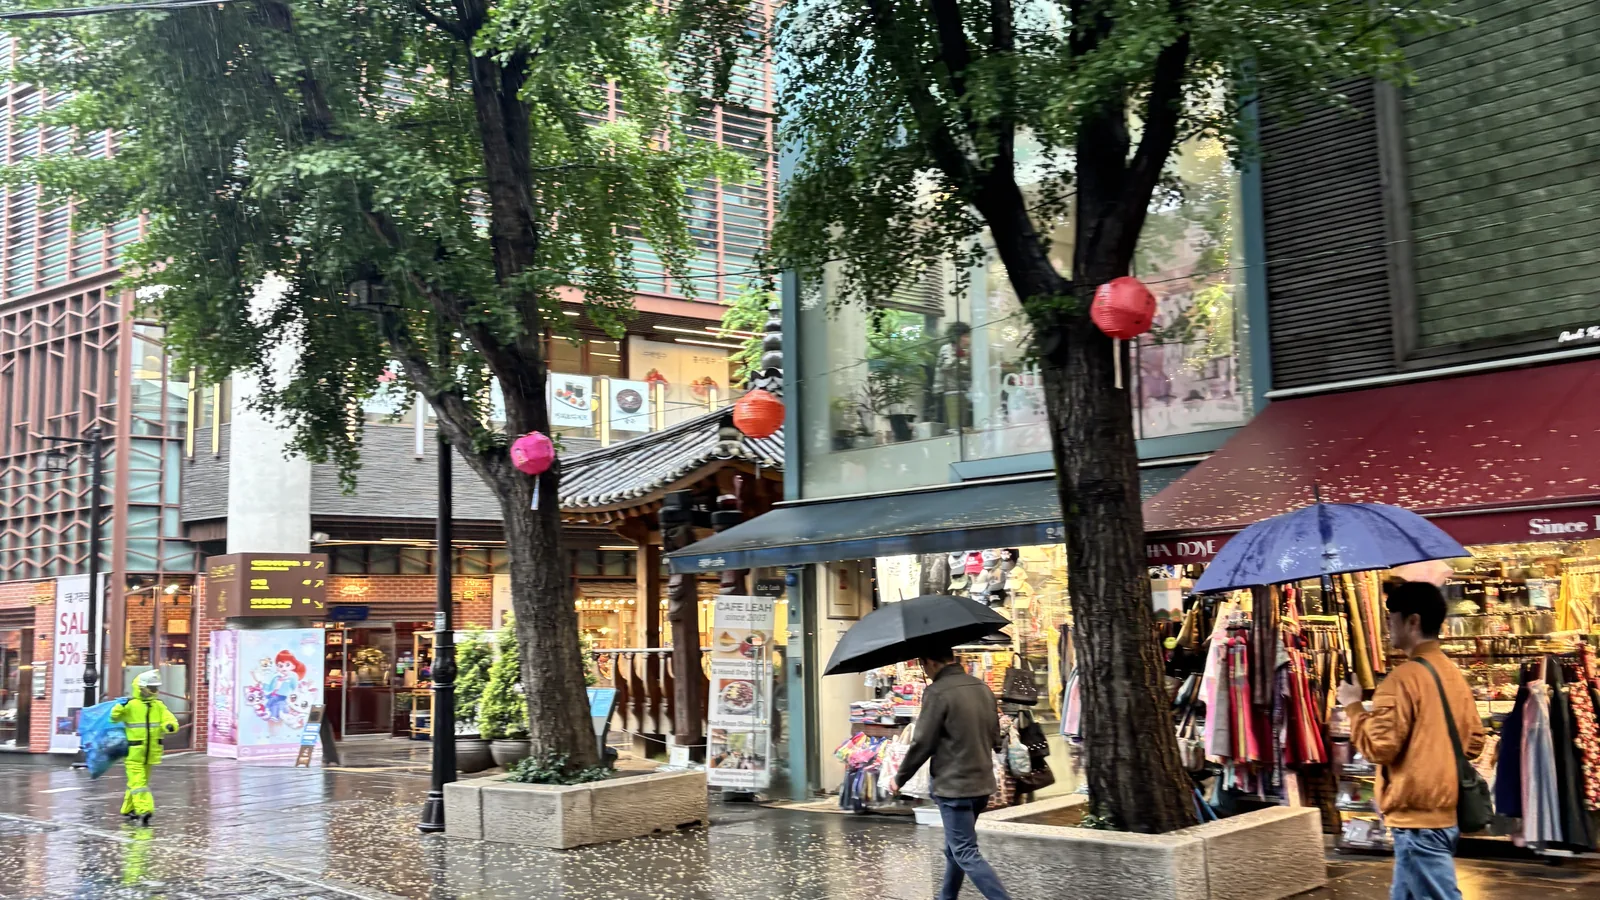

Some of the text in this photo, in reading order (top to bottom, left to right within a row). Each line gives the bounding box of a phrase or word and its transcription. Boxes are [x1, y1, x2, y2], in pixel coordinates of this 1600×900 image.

[1528, 518, 1589, 535] Since
[716, 602, 772, 613] CAFE LEAH
[60, 612, 89, 635] SAL
